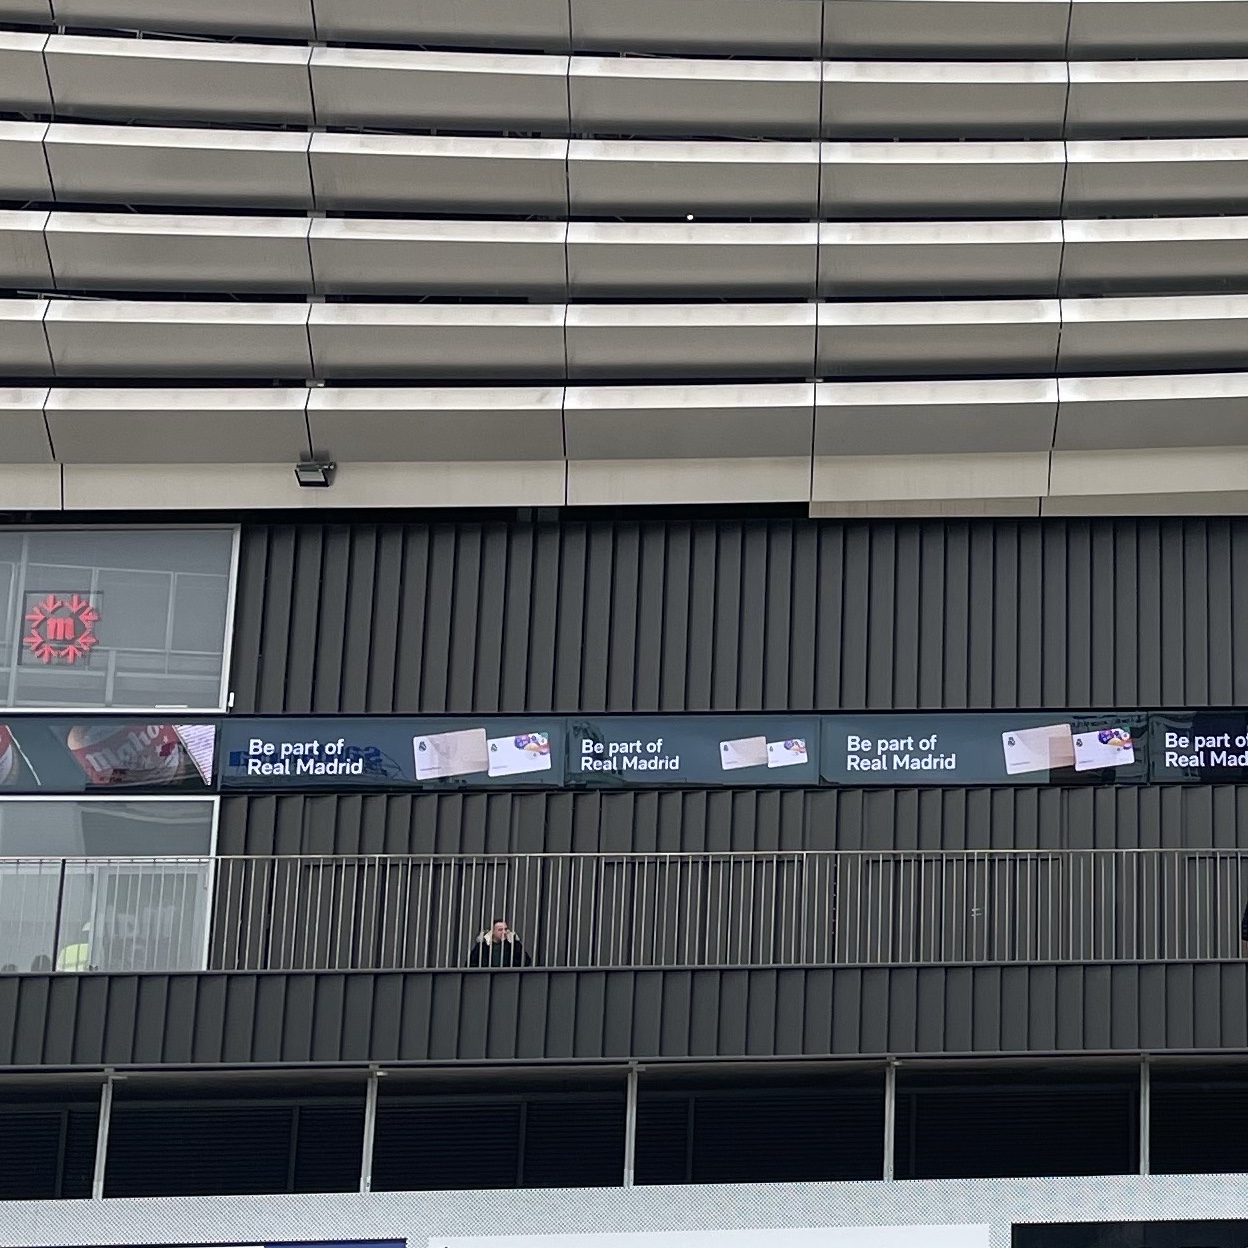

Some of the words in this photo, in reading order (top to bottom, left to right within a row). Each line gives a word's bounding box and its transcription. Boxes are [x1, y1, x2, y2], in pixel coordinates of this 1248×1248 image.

[249, 739, 274, 755] Be
[281, 740, 319, 760] part
[325, 739, 345, 755] of
[582, 739, 604, 754] Be
[608, 740, 642, 757] part
[646, 739, 663, 753] of
[847, 735, 872, 751] Be
[878, 736, 914, 755] part
[919, 734, 937, 750] of
[1165, 732, 1189, 748] Be
[1195, 733, 1231, 752] part
[248, 759, 290, 775] Real
[297, 758, 363, 775] Madrid
[581, 756, 617, 771] Real
[623, 755, 680, 770] Madrid
[847, 754, 887, 770] Real
[893, 753, 956, 770] Madrid
[1165, 751, 1205, 767] Real
